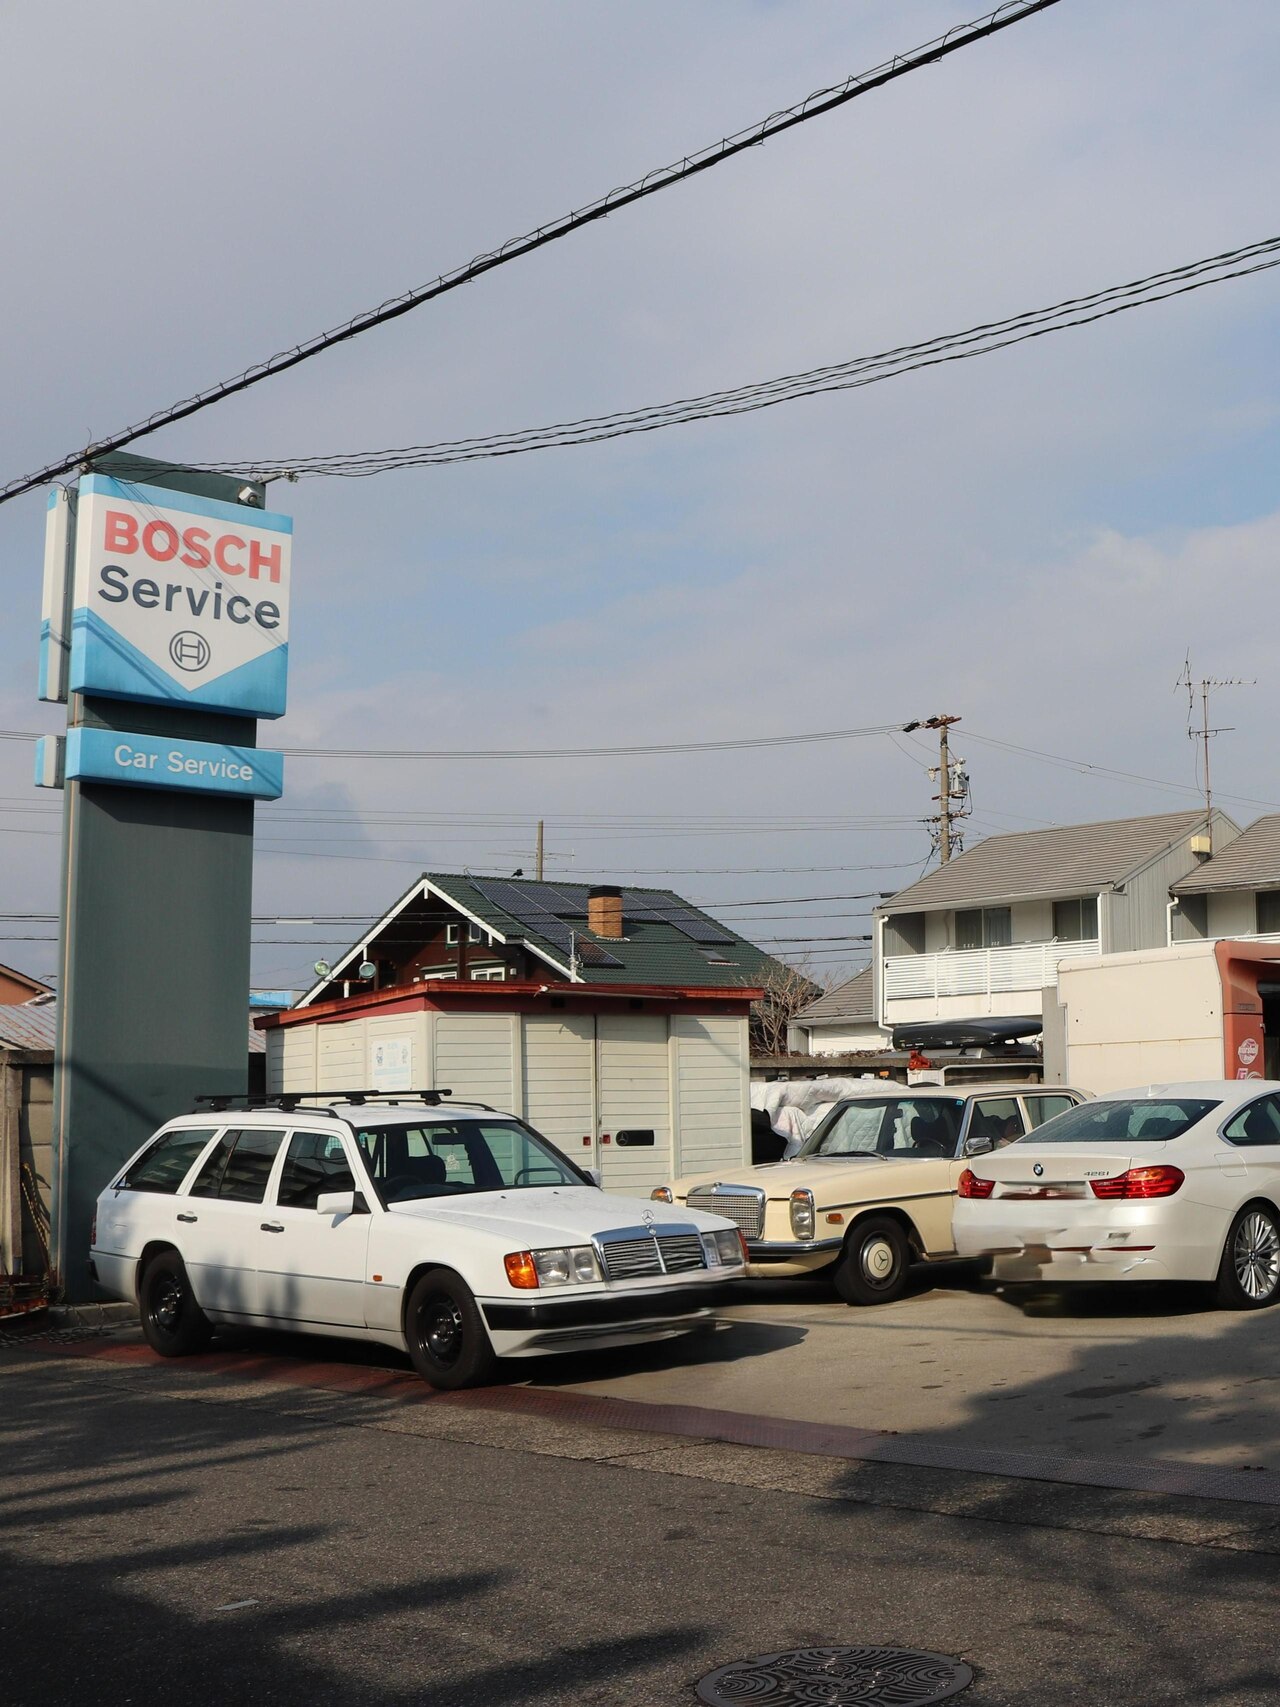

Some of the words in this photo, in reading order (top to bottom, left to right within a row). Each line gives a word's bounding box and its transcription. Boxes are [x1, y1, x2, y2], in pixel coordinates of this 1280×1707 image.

[104, 510, 282, 584] BOSCH
[98, 565, 281, 630] Service
[114, 745, 158, 770] Car
[167, 751, 253, 782] Service
